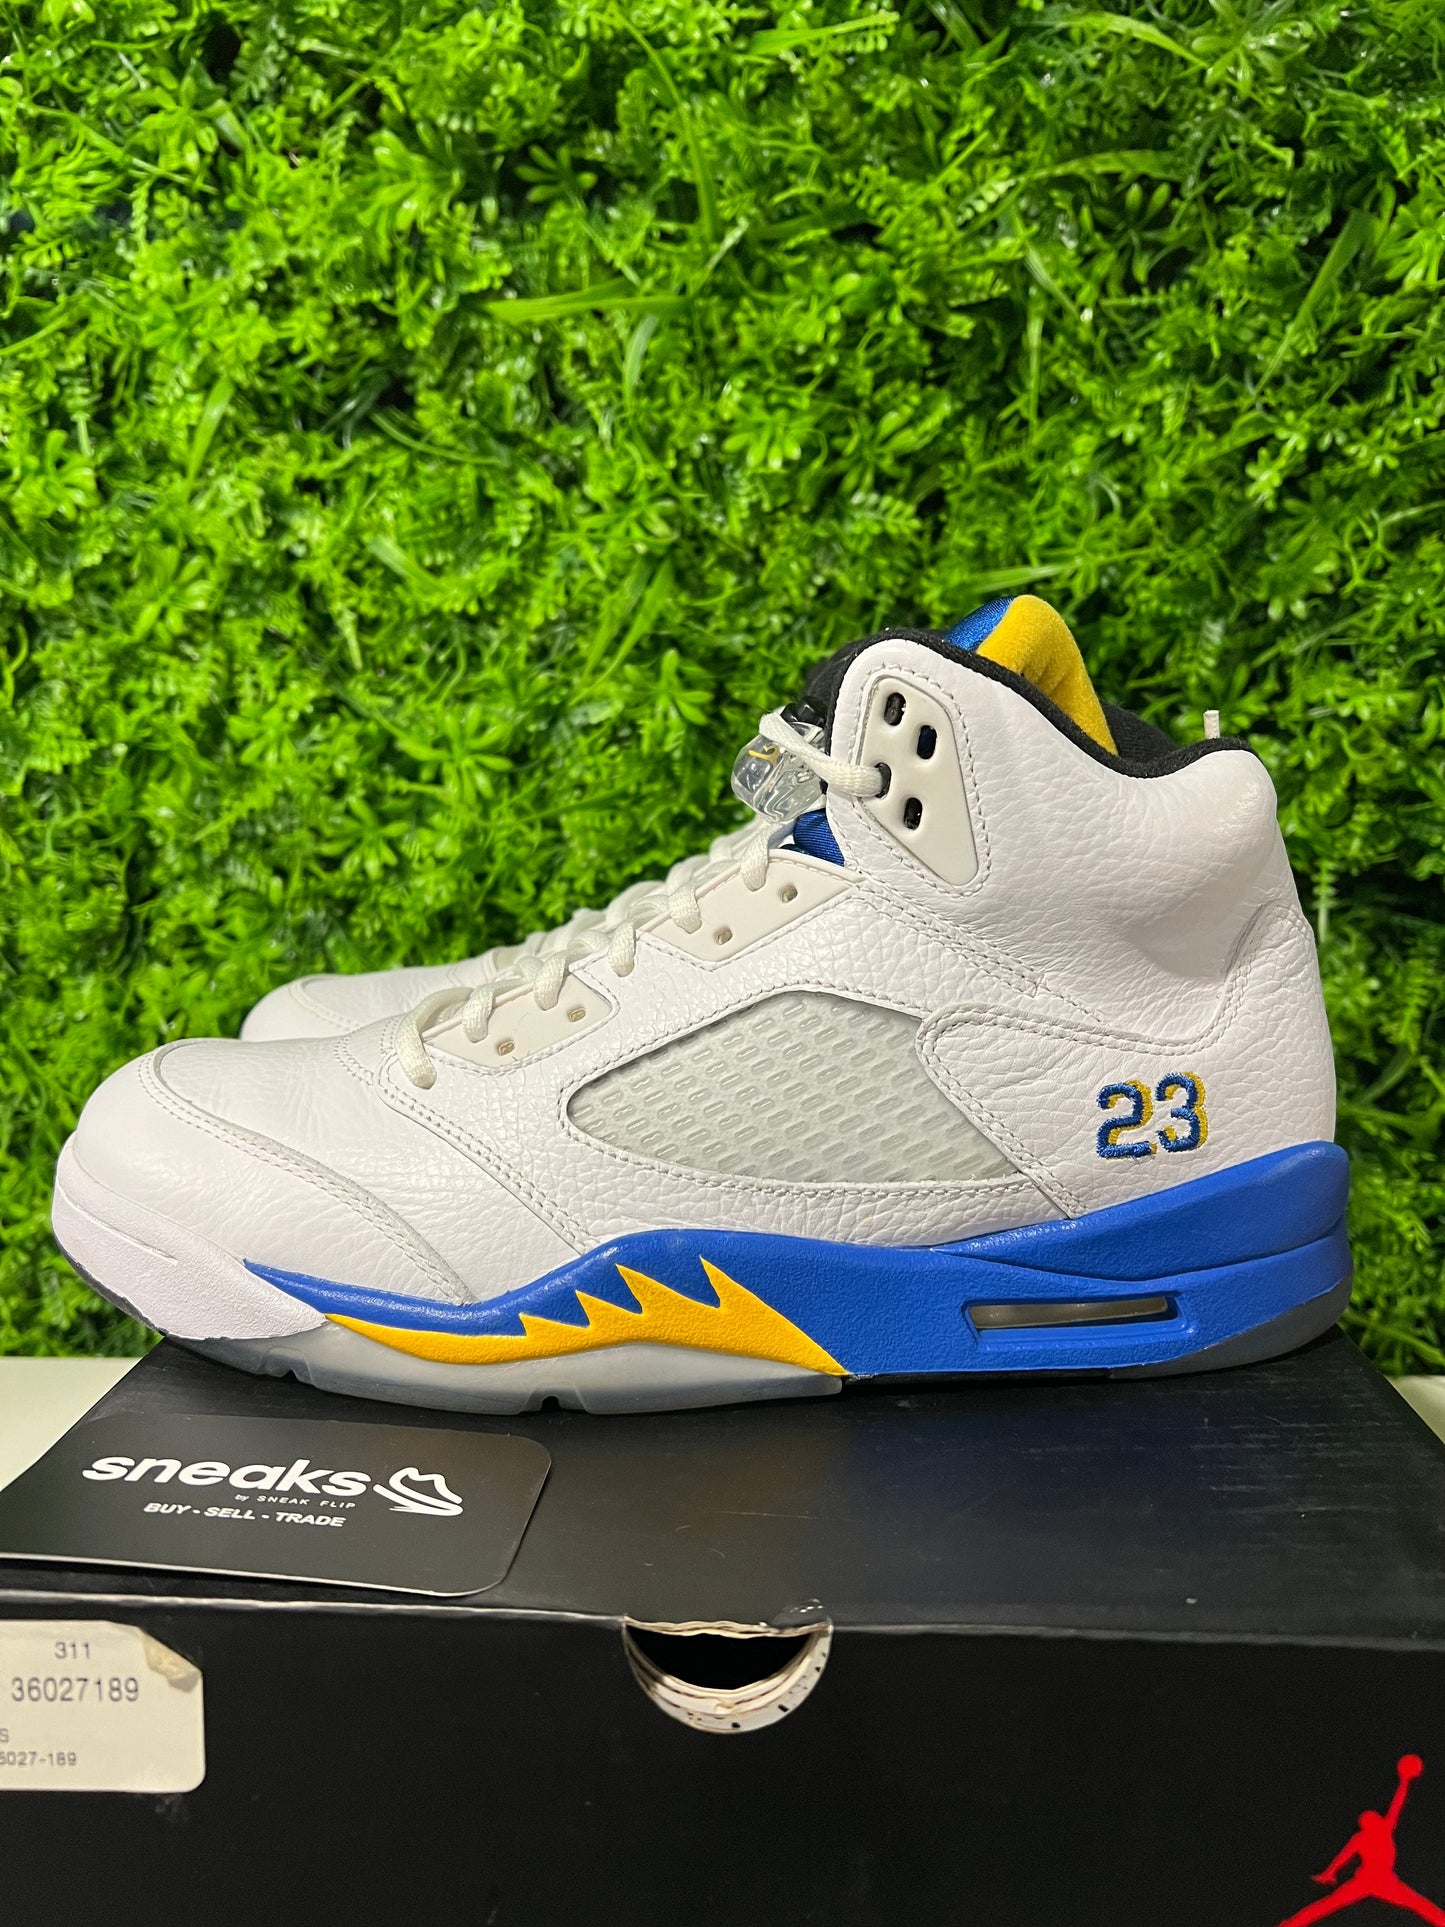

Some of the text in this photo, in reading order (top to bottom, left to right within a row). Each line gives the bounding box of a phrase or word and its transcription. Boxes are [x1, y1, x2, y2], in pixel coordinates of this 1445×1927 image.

[1096, 1071, 1208, 1160] 23
[82, 1456, 372, 1497] sneaks
[256, 1494, 310, 1506] SNEAK
[319, 1500, 356, 1509] FLIP
[143, 1502, 192, 1515] BUY
[203, 1506, 256, 1520] SELL
[275, 1511, 346, 1528] TRADE
[54, 1641, 91, 1660] 311
[11, 1676, 140, 1702] 36027189
